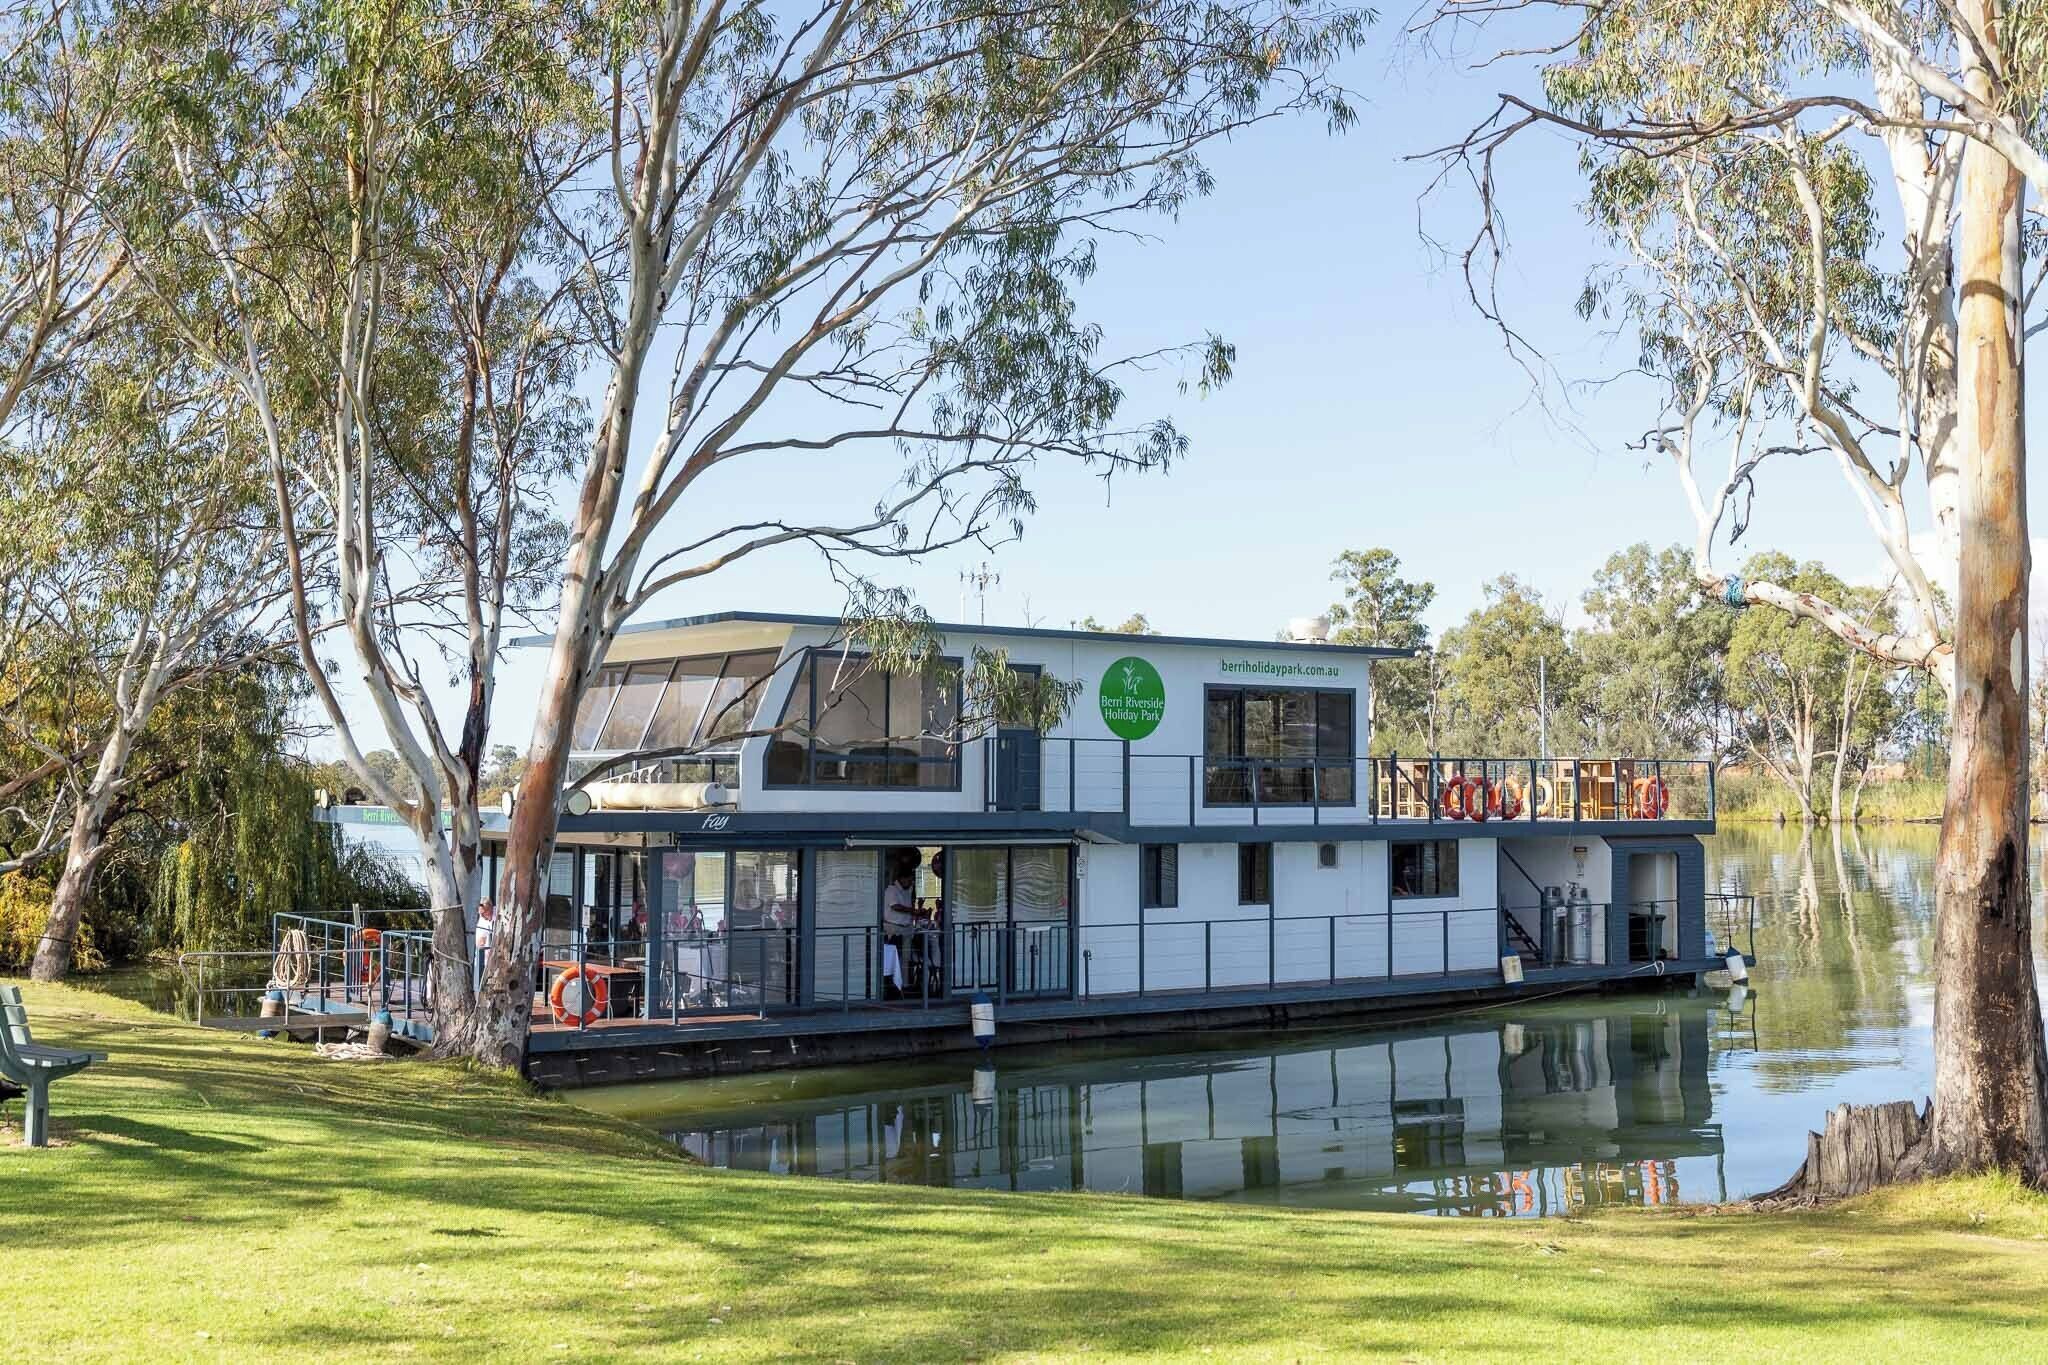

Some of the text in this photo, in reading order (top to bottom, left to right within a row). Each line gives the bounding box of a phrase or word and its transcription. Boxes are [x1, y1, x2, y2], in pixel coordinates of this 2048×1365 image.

[1221, 659, 1339, 677] berriholidaypark.com.au
[1101, 695, 1164, 709] Berri Riverside
[1105, 708, 1160, 722] Holiday Park
[701, 813, 730, 830] Fay
